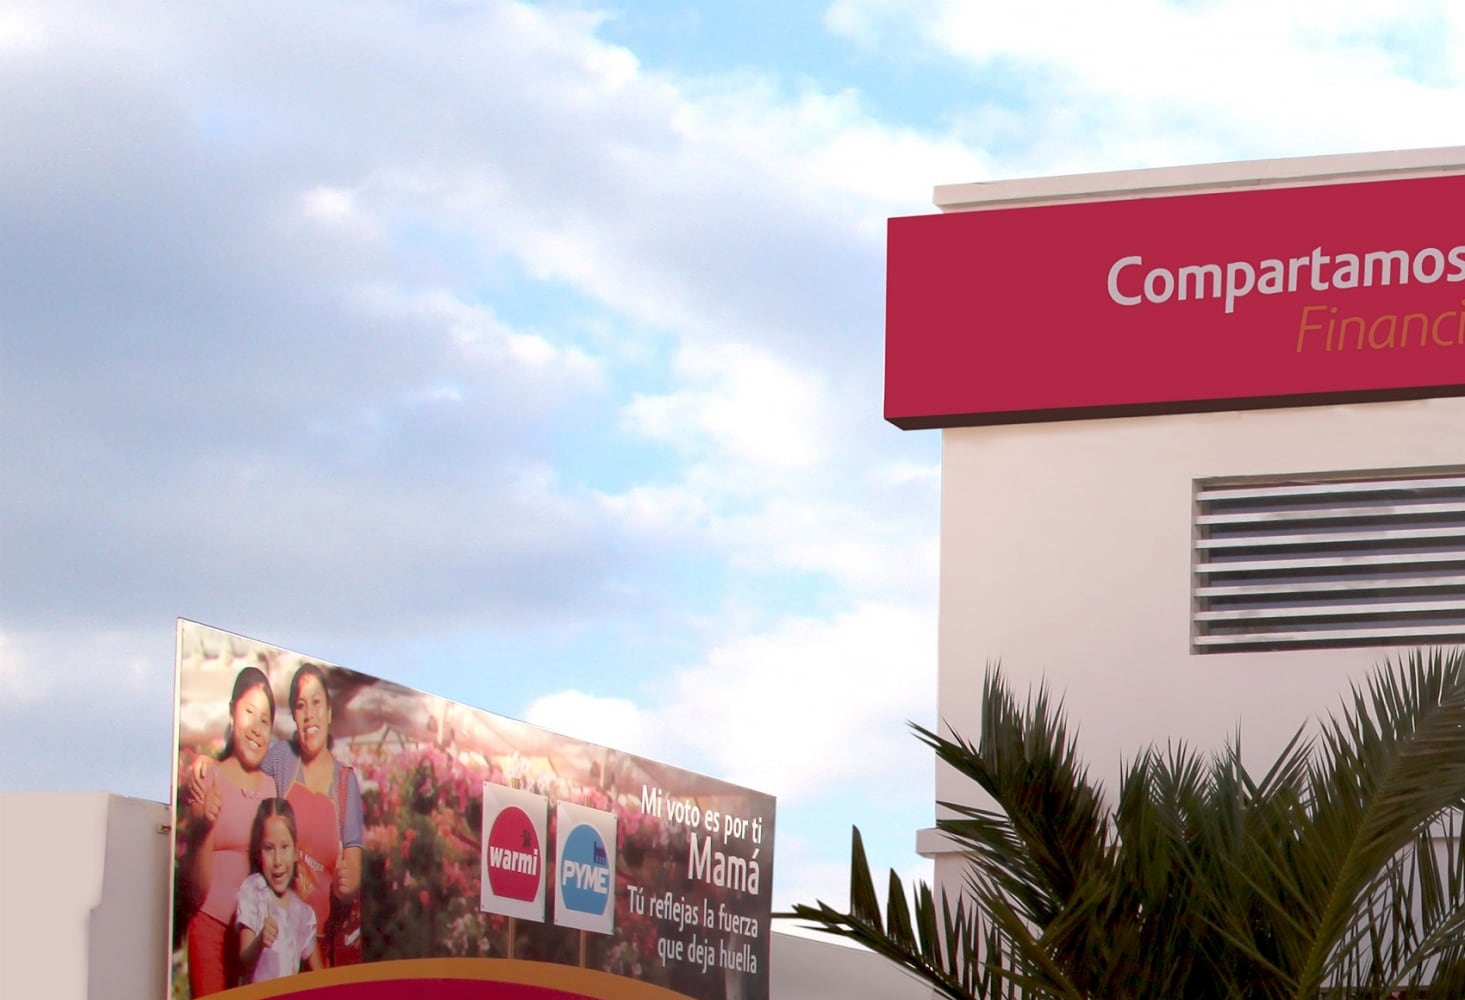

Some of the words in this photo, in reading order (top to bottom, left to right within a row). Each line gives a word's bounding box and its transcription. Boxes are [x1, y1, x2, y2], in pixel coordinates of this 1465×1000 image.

[641, 784, 662, 818] Mi
[666, 798, 700, 828] voto
[704, 807, 720, 833] es
[724, 814, 748, 844] por
[751, 817, 763, 844] ti
[489, 846, 538, 876] warmi
[562, 859, 609, 894] PYME
[688, 832, 760, 895] Mamá
[627, 885, 645, 915] Tú
[650, 892, 699, 932] reflejas
[703, 899, 714, 929] la
[719, 903, 759, 938] fuerza
[657, 936, 683, 967] que
[688, 934, 715, 974] deja
[719, 939, 757, 974] huella
